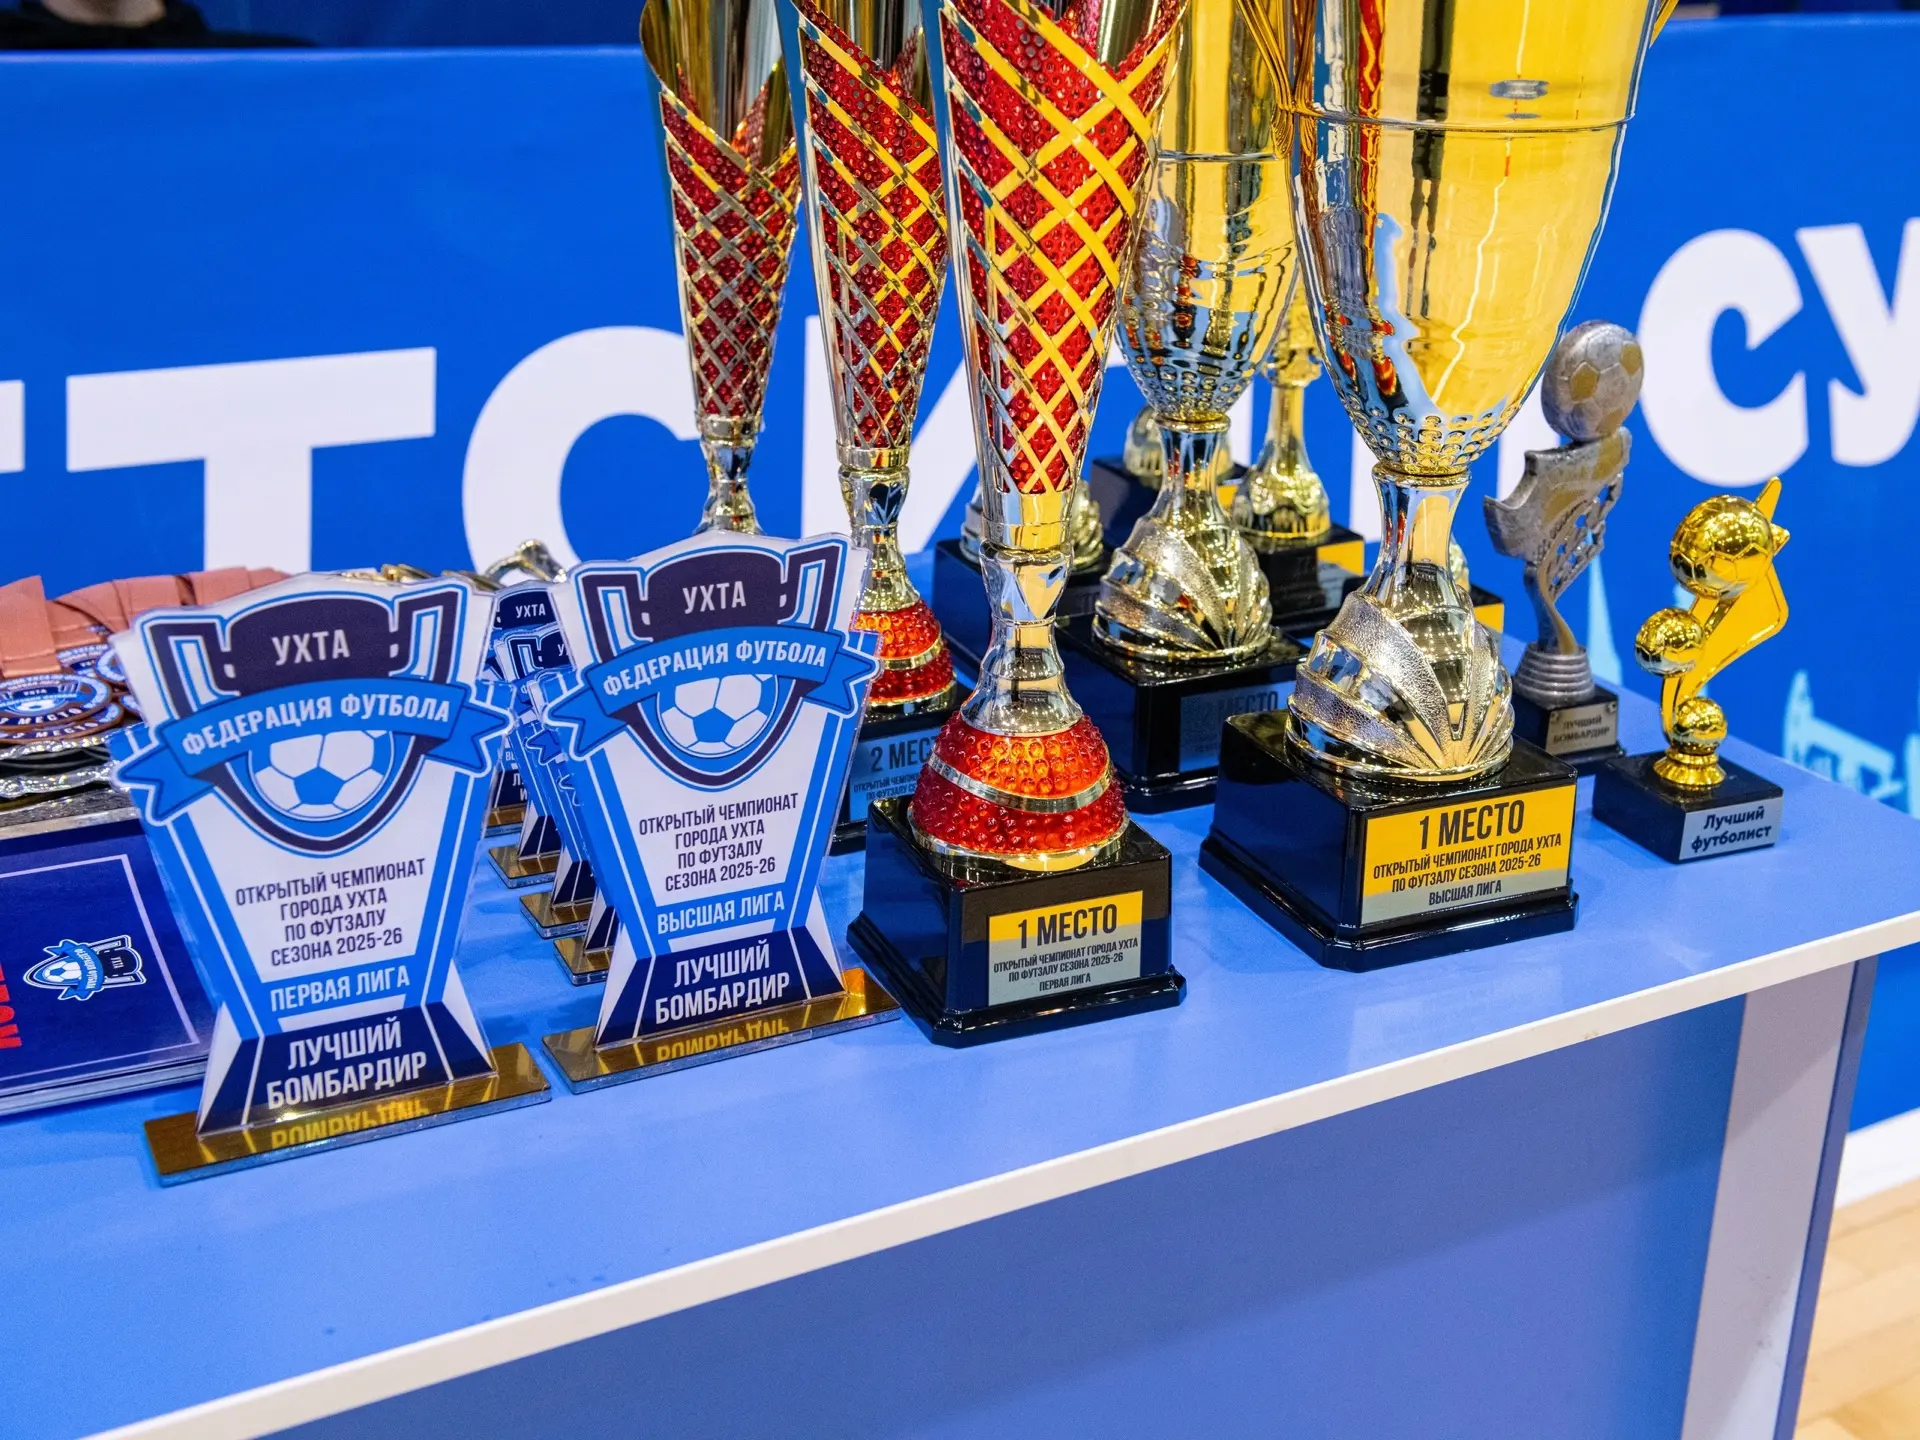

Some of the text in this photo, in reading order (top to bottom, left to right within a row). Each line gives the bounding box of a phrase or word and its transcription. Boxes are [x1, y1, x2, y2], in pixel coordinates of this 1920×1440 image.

[515, 603, 546, 618] УХТА
[682, 581, 746, 614] УХТА
[271, 629, 351, 666] УХТА
[602, 640, 827, 696] ФЕДЕРАЦИЯ ФУТБОЛА
[182, 693, 450, 756] ФЕДЕРАЦИЯ ФУТБОЛА
[1553, 727, 1610, 743] БОМБАРДИР
[1563, 715, 1602, 730] ЛУЧШИЙ
[871, 737, 936, 772] 2 МЕС
[639, 793, 798, 836] ОТКРЫТЫЙ ЧЕМПИОНАТ
[1420, 800, 1525, 850] 1 МЕСТО
[1703, 806, 1765, 830] Лучший
[675, 819, 765, 850] ГОРОДА УХТА
[1691, 825, 1772, 853] футболист
[677, 839, 763, 869] ПО ФУТЗАЛУ
[1373, 833, 1562, 879] ОТКРЫТЫЙ ЧЕМПИОНАТ ГОРОДА УХТА
[235, 858, 426, 906] ОТКРЫТЫЙ ЧЕМПИОНАТ
[665, 857, 776, 892] СЕЗОНА 2025-26
[1392, 853, 1541, 893] ПО ФУТЗАЛУ СЕЗОНА 2025-26
[280, 887, 388, 921] ГОРОДА УХТА
[1429, 880, 1502, 906] ВЫСШАЯ ЛИГА
[284, 908, 386, 943] ПО ФУТЗАЛУ
[657, 891, 785, 935] ВЫСШАЯ ЛИГА
[1018, 904, 1118, 949] 1 МЕСТО
[270, 927, 403, 966] СЕЗОНА 2025-26
[674, 939, 770, 988] ЛУЧШИЙ
[993, 937, 1139, 973] ОТКРЫТЫЙ ЧЕМПИОНАТ ГОРОДА УХТА
[1008, 952, 1124, 983] ПО ФУТЗАЛУ СЕЗОНА 2025-26
[1039, 973, 1091, 992] ПЕРВАЯ ЛИГА
[269, 965, 411, 1012] ПЕРВАЯ ЛИГА
[655, 972, 790, 1025] БОМБАРДИР
[287, 1016, 402, 1070] ЛУЧШИЙ
[266, 1051, 427, 1110] БОМБАРДИР
